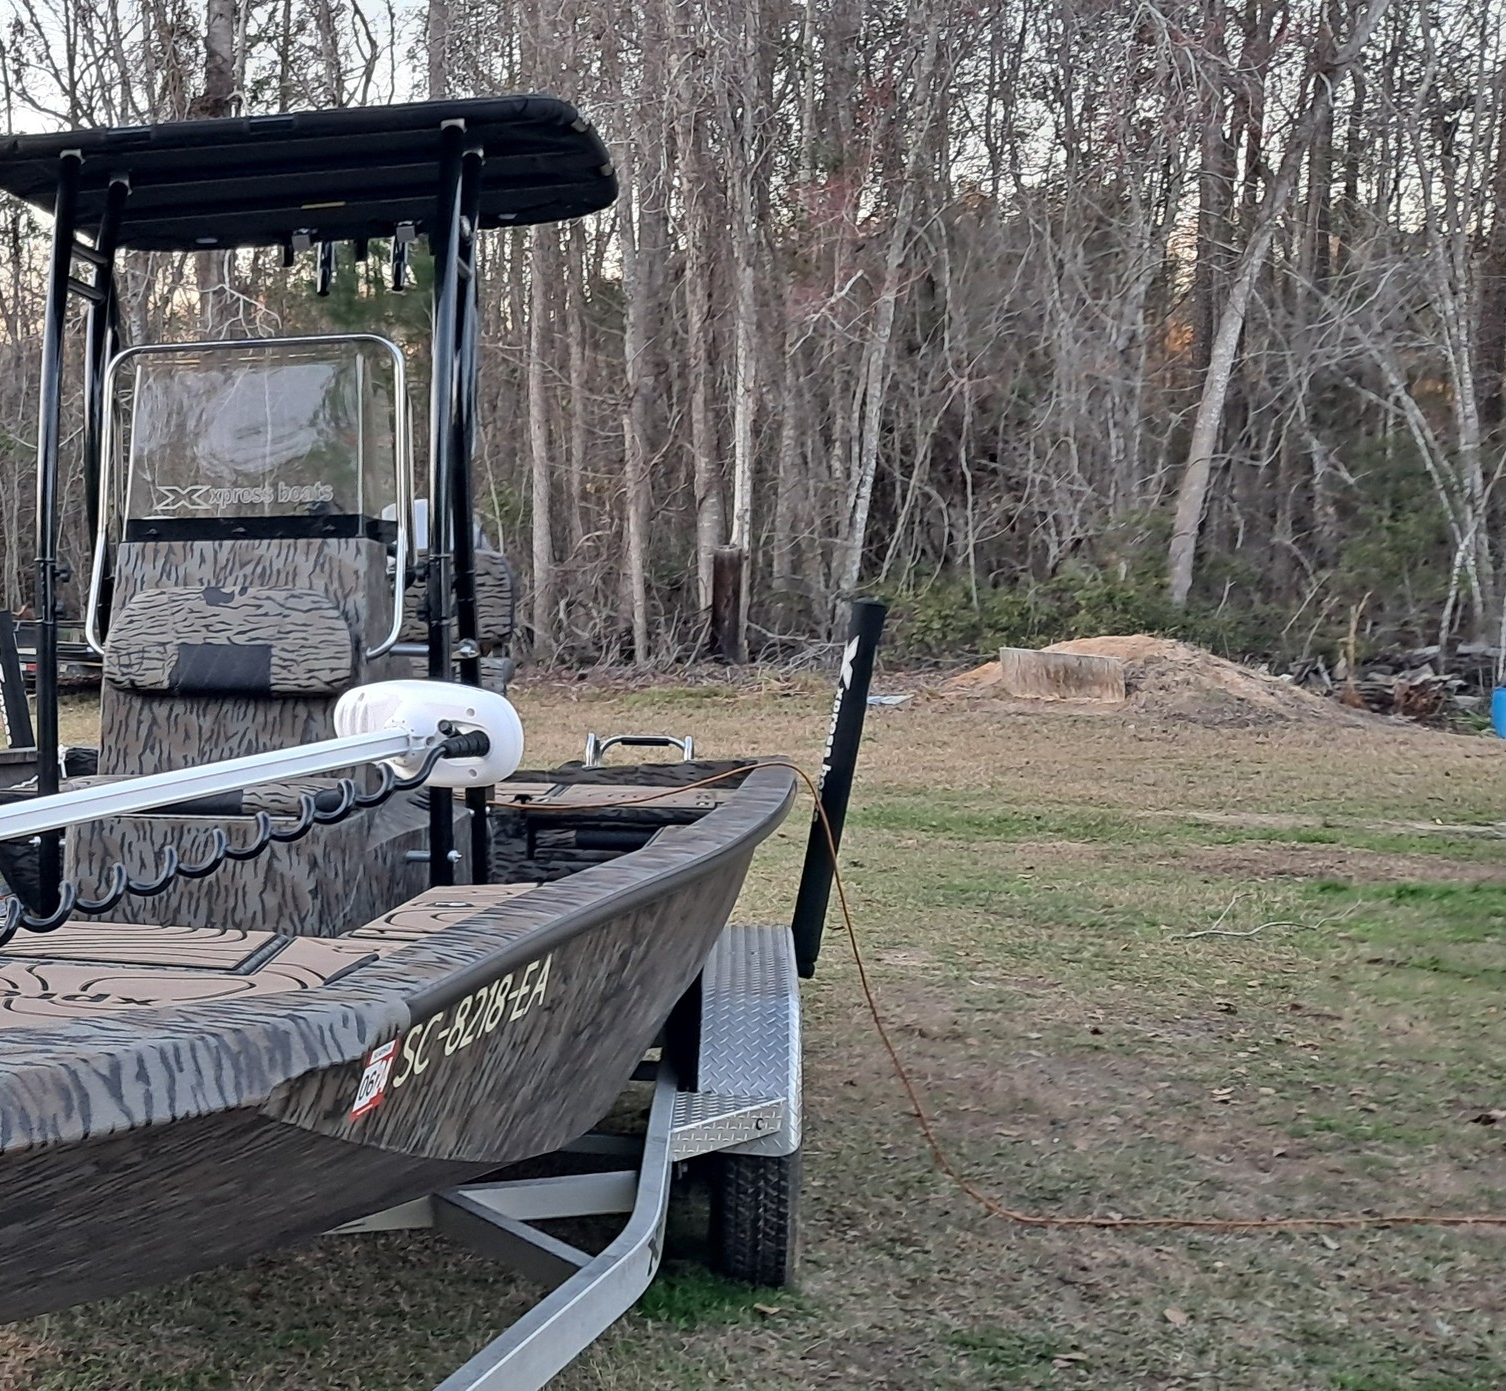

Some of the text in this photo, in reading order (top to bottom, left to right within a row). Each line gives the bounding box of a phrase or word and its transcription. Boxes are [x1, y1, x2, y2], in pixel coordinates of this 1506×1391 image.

[209, 486, 274, 508] xpress
[277, 481, 334, 503] boats
[393, 952, 553, 1088] SC-8218-EA
